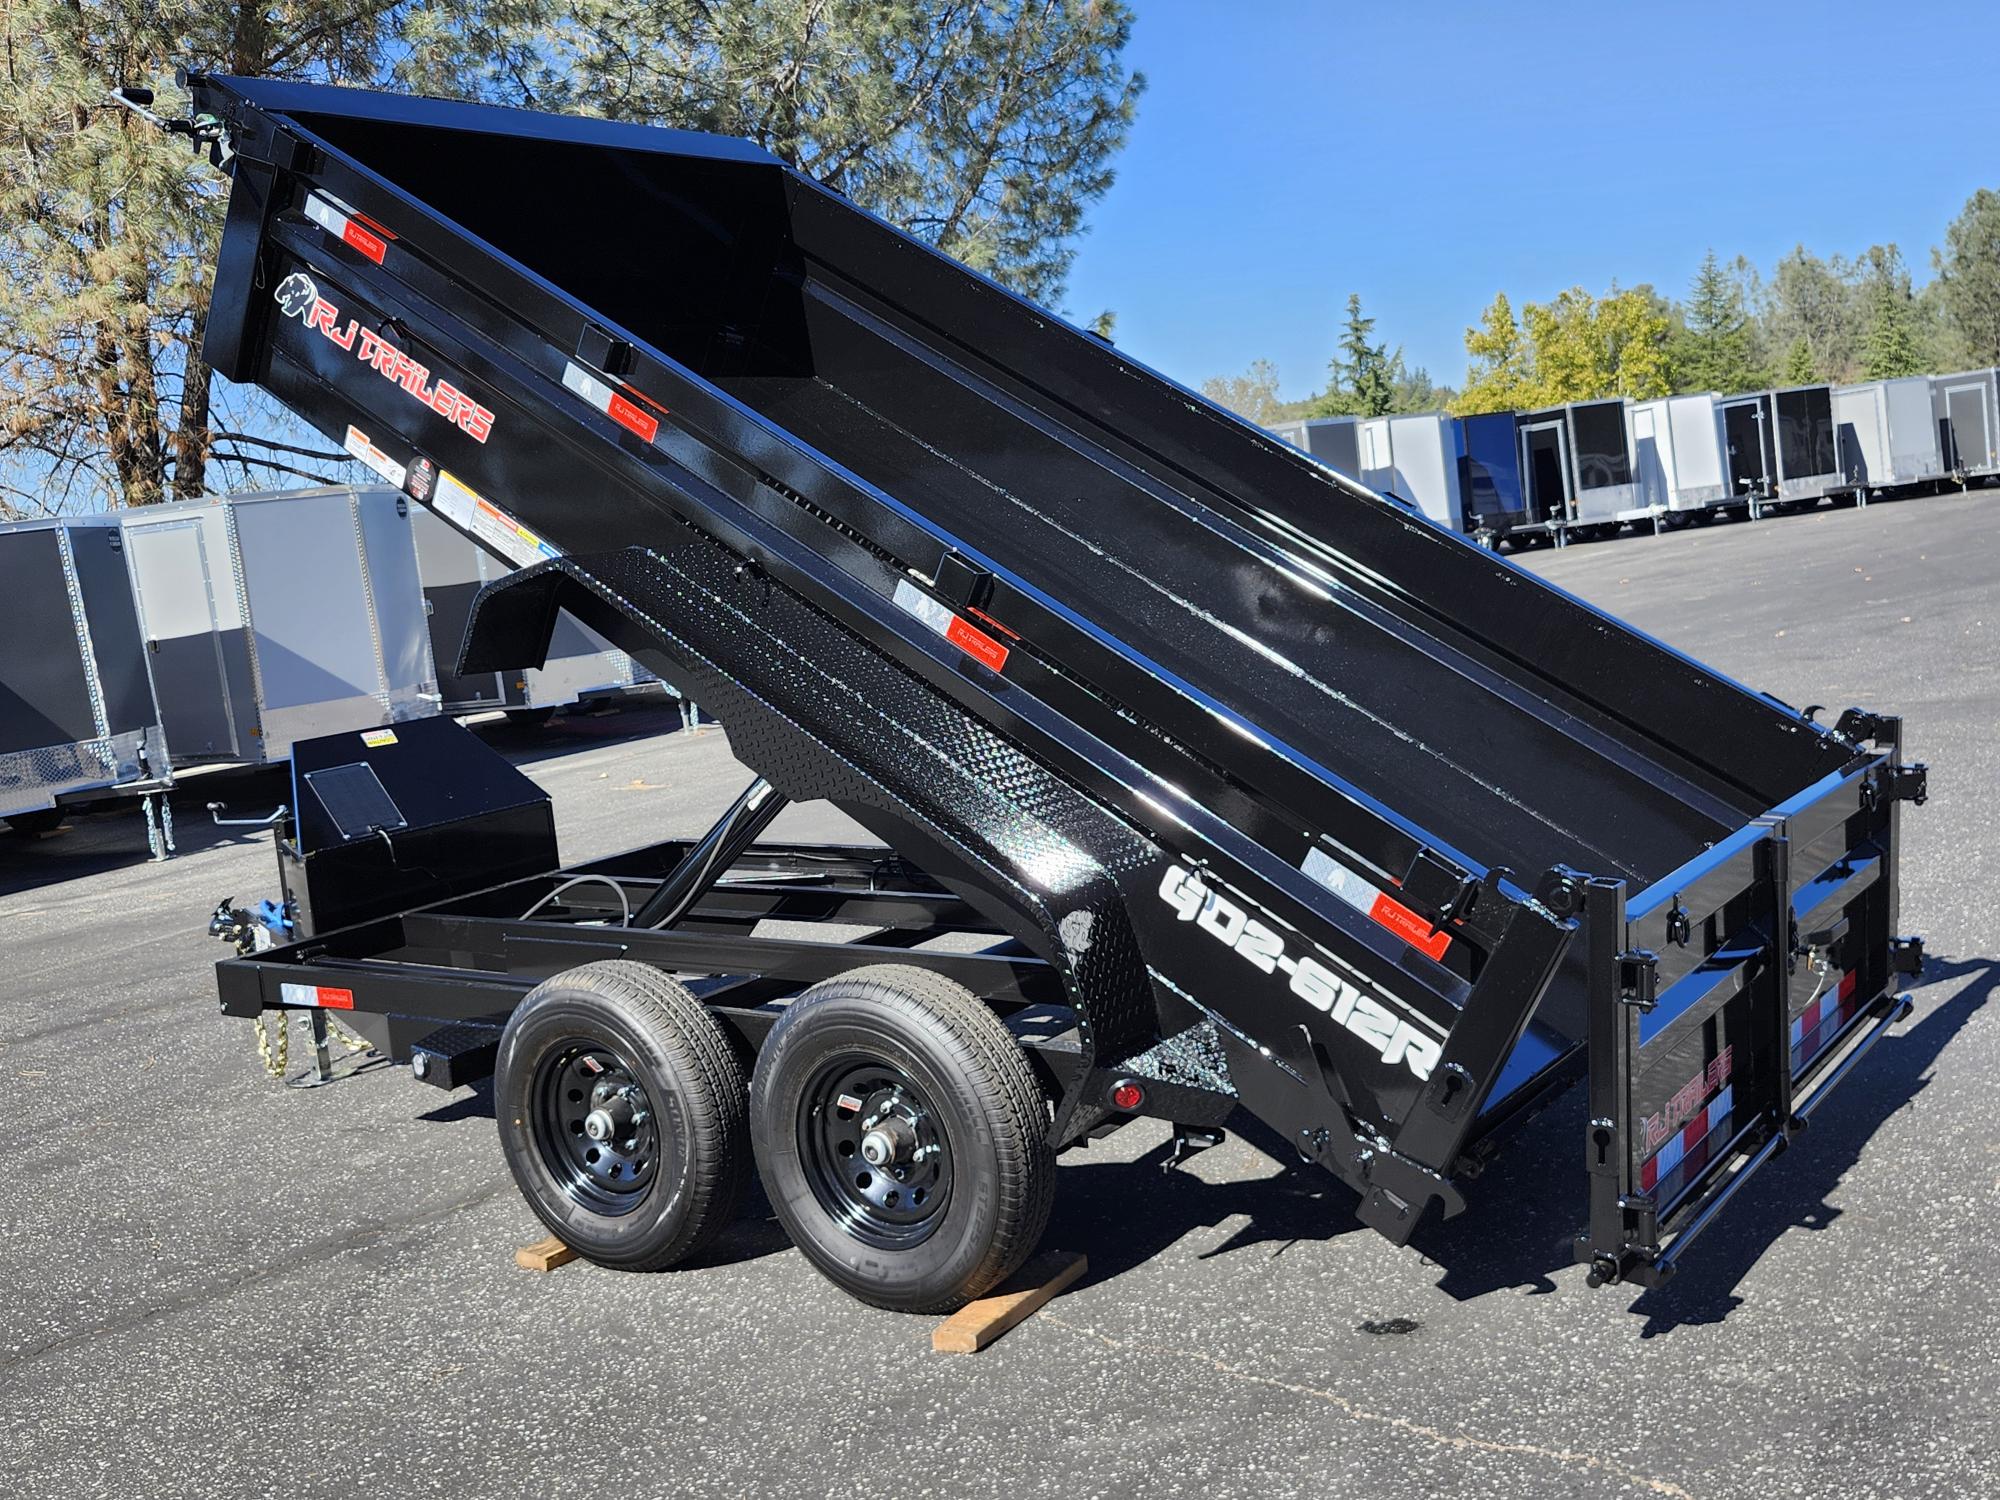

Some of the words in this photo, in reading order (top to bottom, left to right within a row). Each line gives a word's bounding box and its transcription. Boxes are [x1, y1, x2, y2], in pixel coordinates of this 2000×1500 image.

[309, 297, 359, 352] RJ
[357, 326, 496, 445] TRAILERS
[1158, 864, 1443, 1082] GD2-612R
[1395, 913, 1431, 944] TRAILER
[1646, 1102, 1671, 1154] RJ
[1670, 1044, 1733, 1124] TRAILERS
